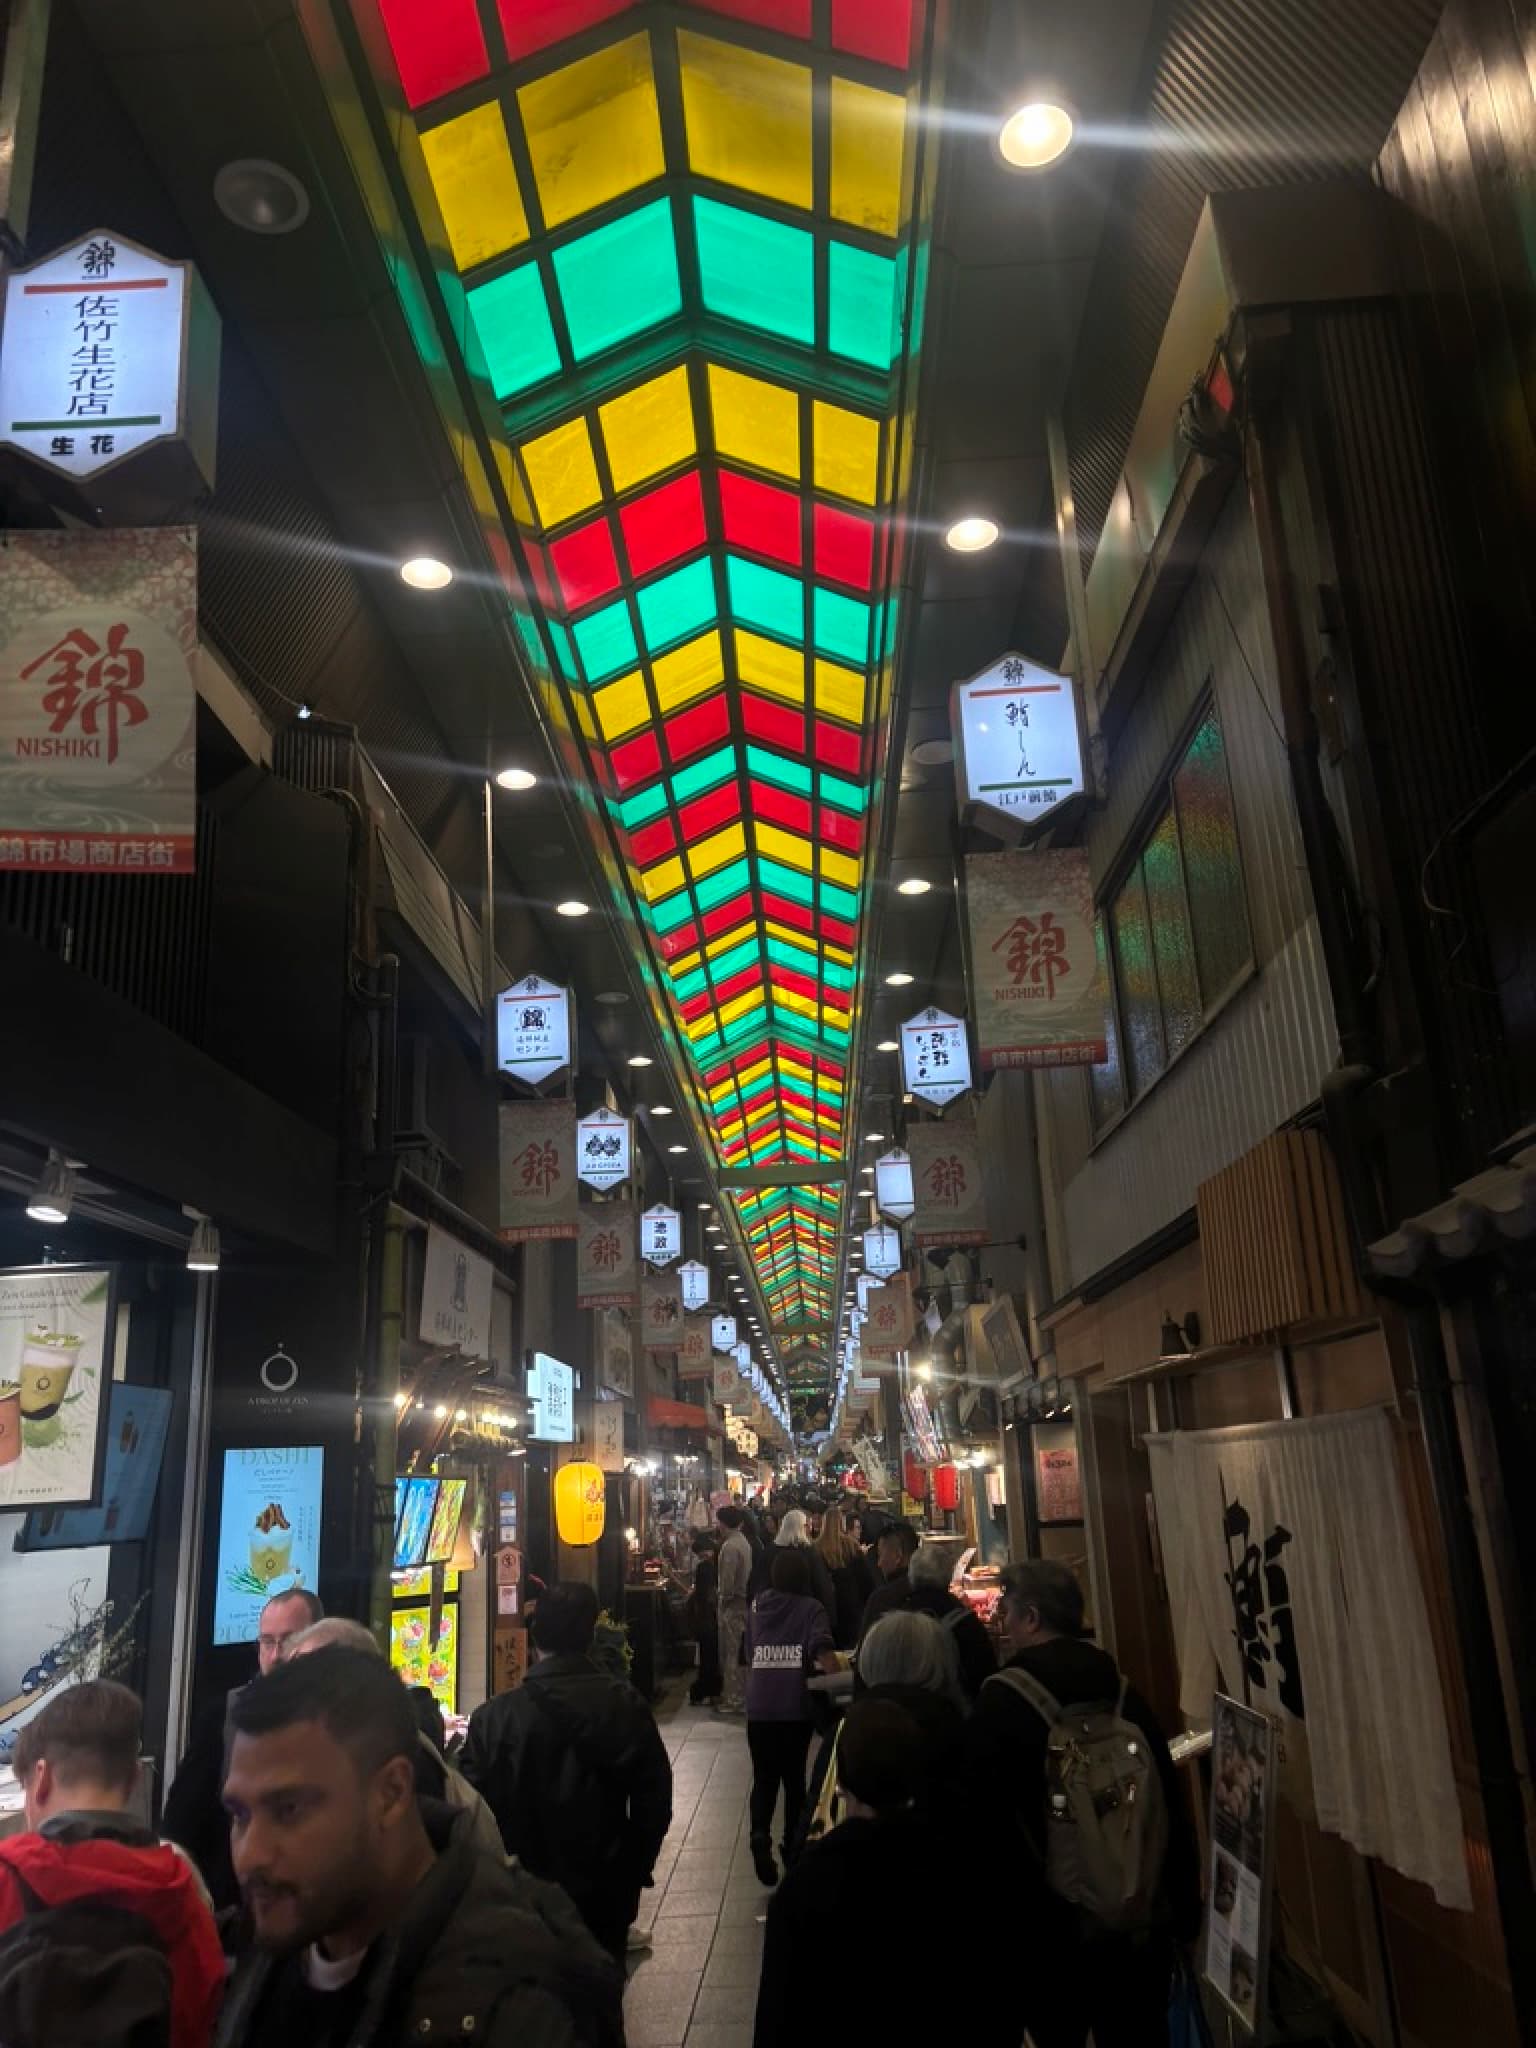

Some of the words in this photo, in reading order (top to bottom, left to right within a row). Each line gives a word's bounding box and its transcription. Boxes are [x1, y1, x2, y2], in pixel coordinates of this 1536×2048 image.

[77, 240, 116, 279] 錦
[66, 295, 120, 415] 佐竹生花店
[50, 435, 115, 456] 生花
[18, 623, 149, 766] 錦
[16, 737, 100, 758] NISHIKI
[991, 912, 1071, 1001] 錦
[995, 988, 1046, 1001] NISHIKI
